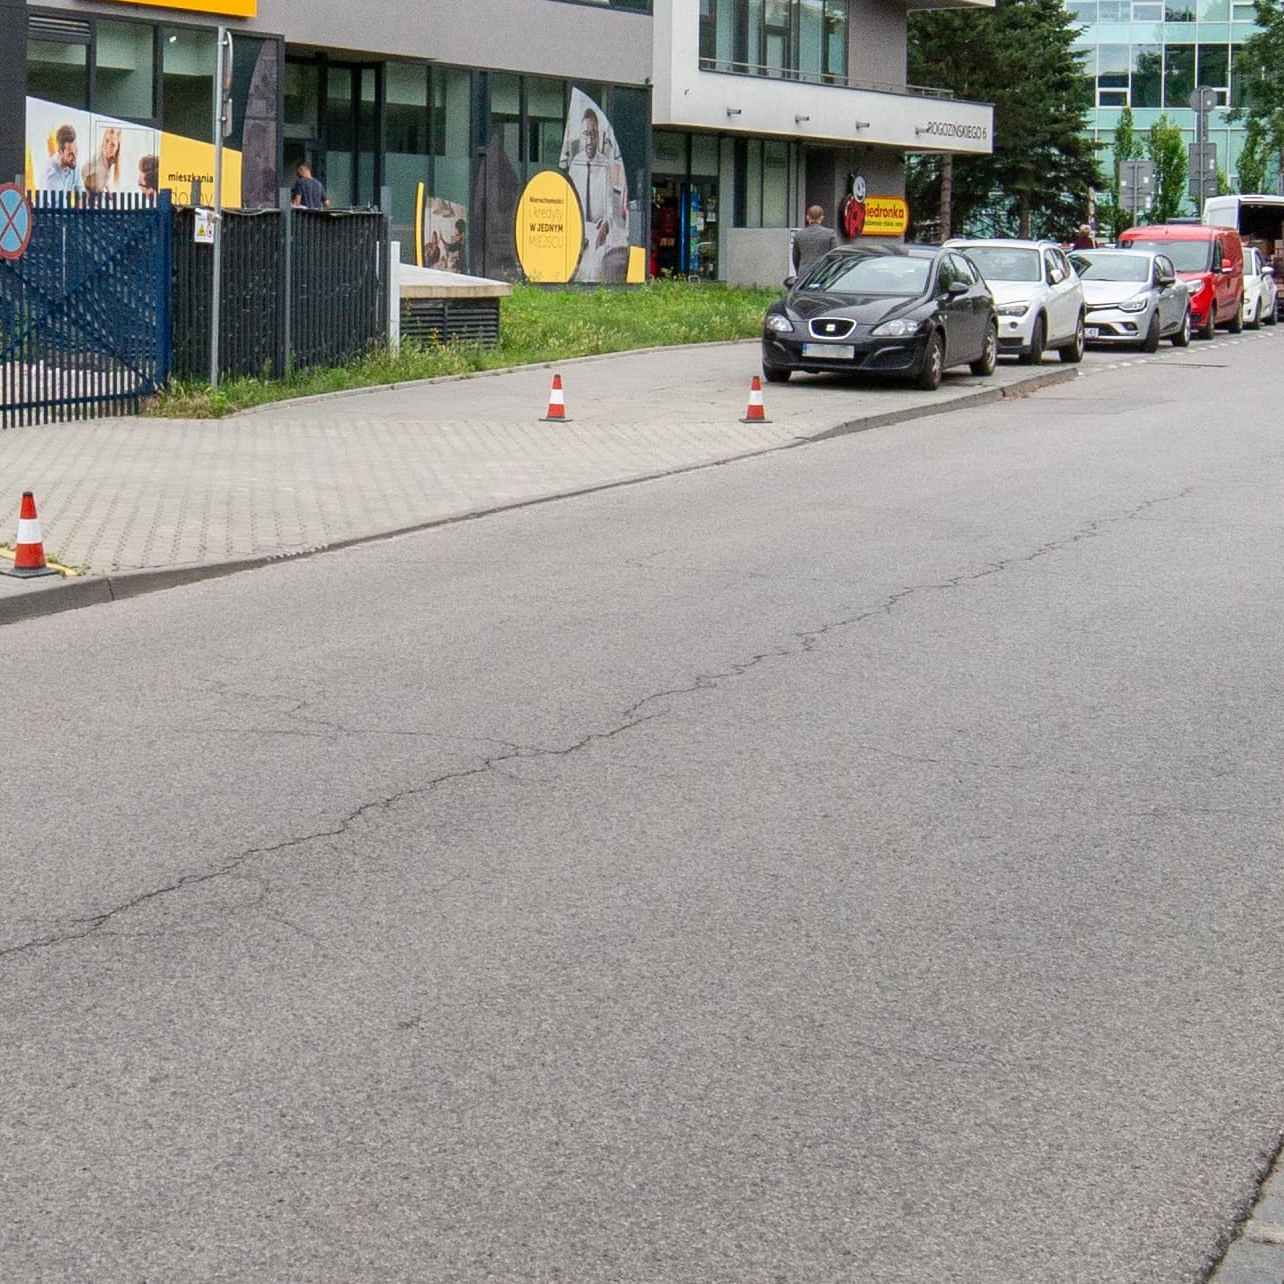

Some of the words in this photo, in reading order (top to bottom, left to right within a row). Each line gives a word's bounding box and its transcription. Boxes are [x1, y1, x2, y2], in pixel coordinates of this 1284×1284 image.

[865, 203, 904, 219] iedronka
[529, 223, 537, 232] W
[537, 223, 564, 233] JEDNYM
